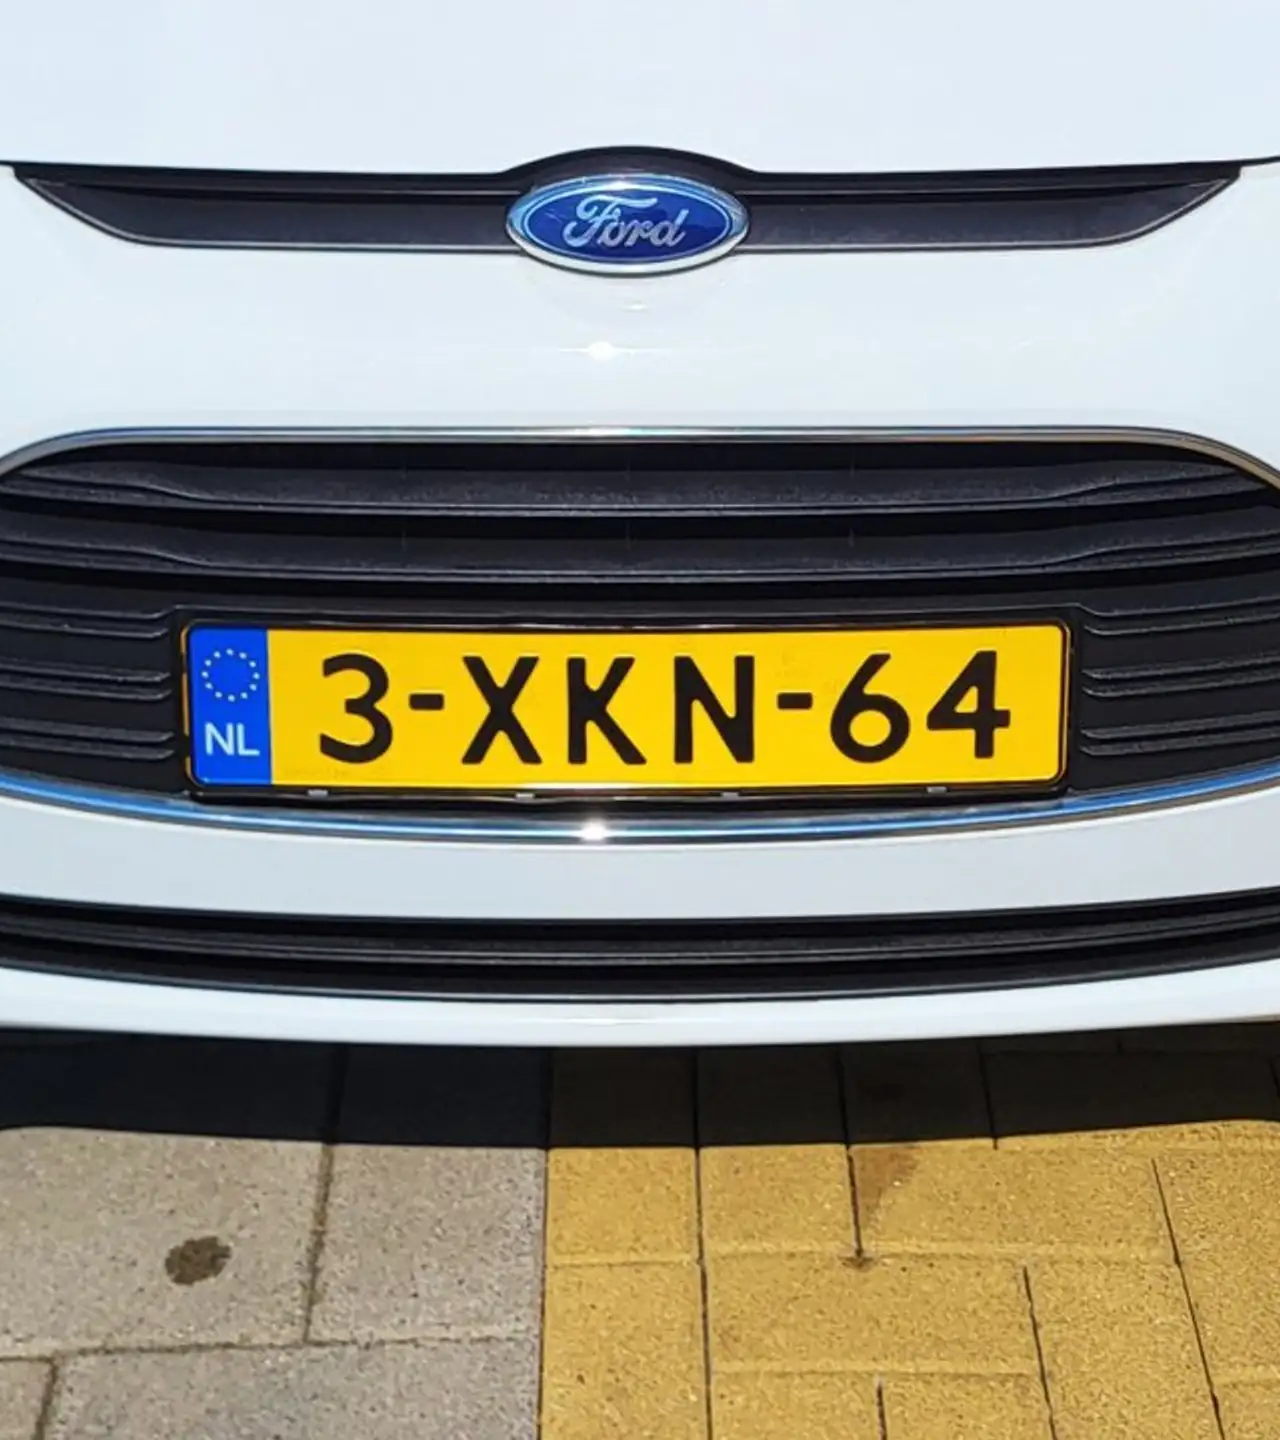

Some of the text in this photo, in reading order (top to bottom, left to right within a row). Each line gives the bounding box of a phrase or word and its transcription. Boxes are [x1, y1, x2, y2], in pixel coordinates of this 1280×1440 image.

[562, 193, 690, 248] Ford
[318, 649, 1012, 766] 3-XKN-64
[204, 721, 262, 757] NL
